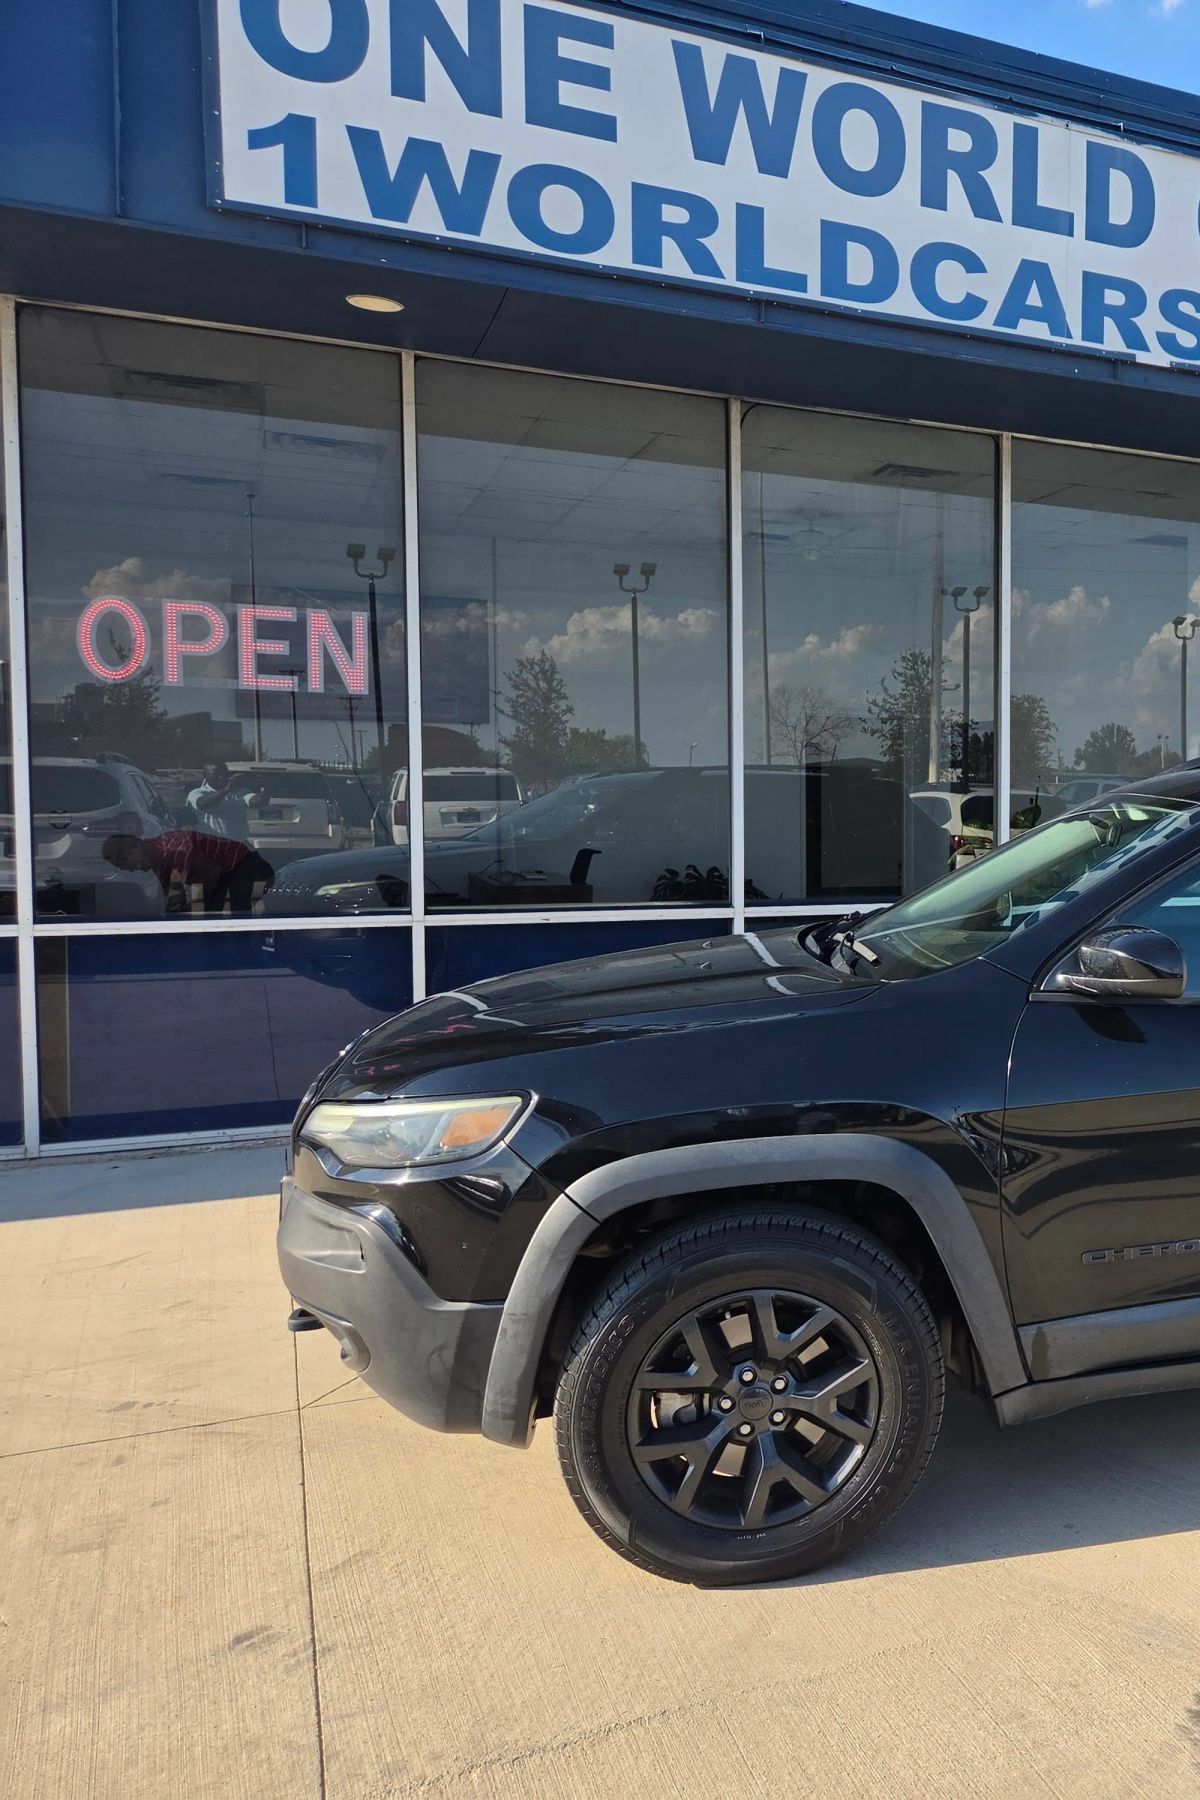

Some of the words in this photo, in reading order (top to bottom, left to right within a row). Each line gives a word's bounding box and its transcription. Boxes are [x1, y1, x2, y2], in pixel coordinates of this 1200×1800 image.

[239, 0, 618, 143] ONE
[671, 39, 1156, 248] WORLD
[76, 596, 369, 695] OPEN
